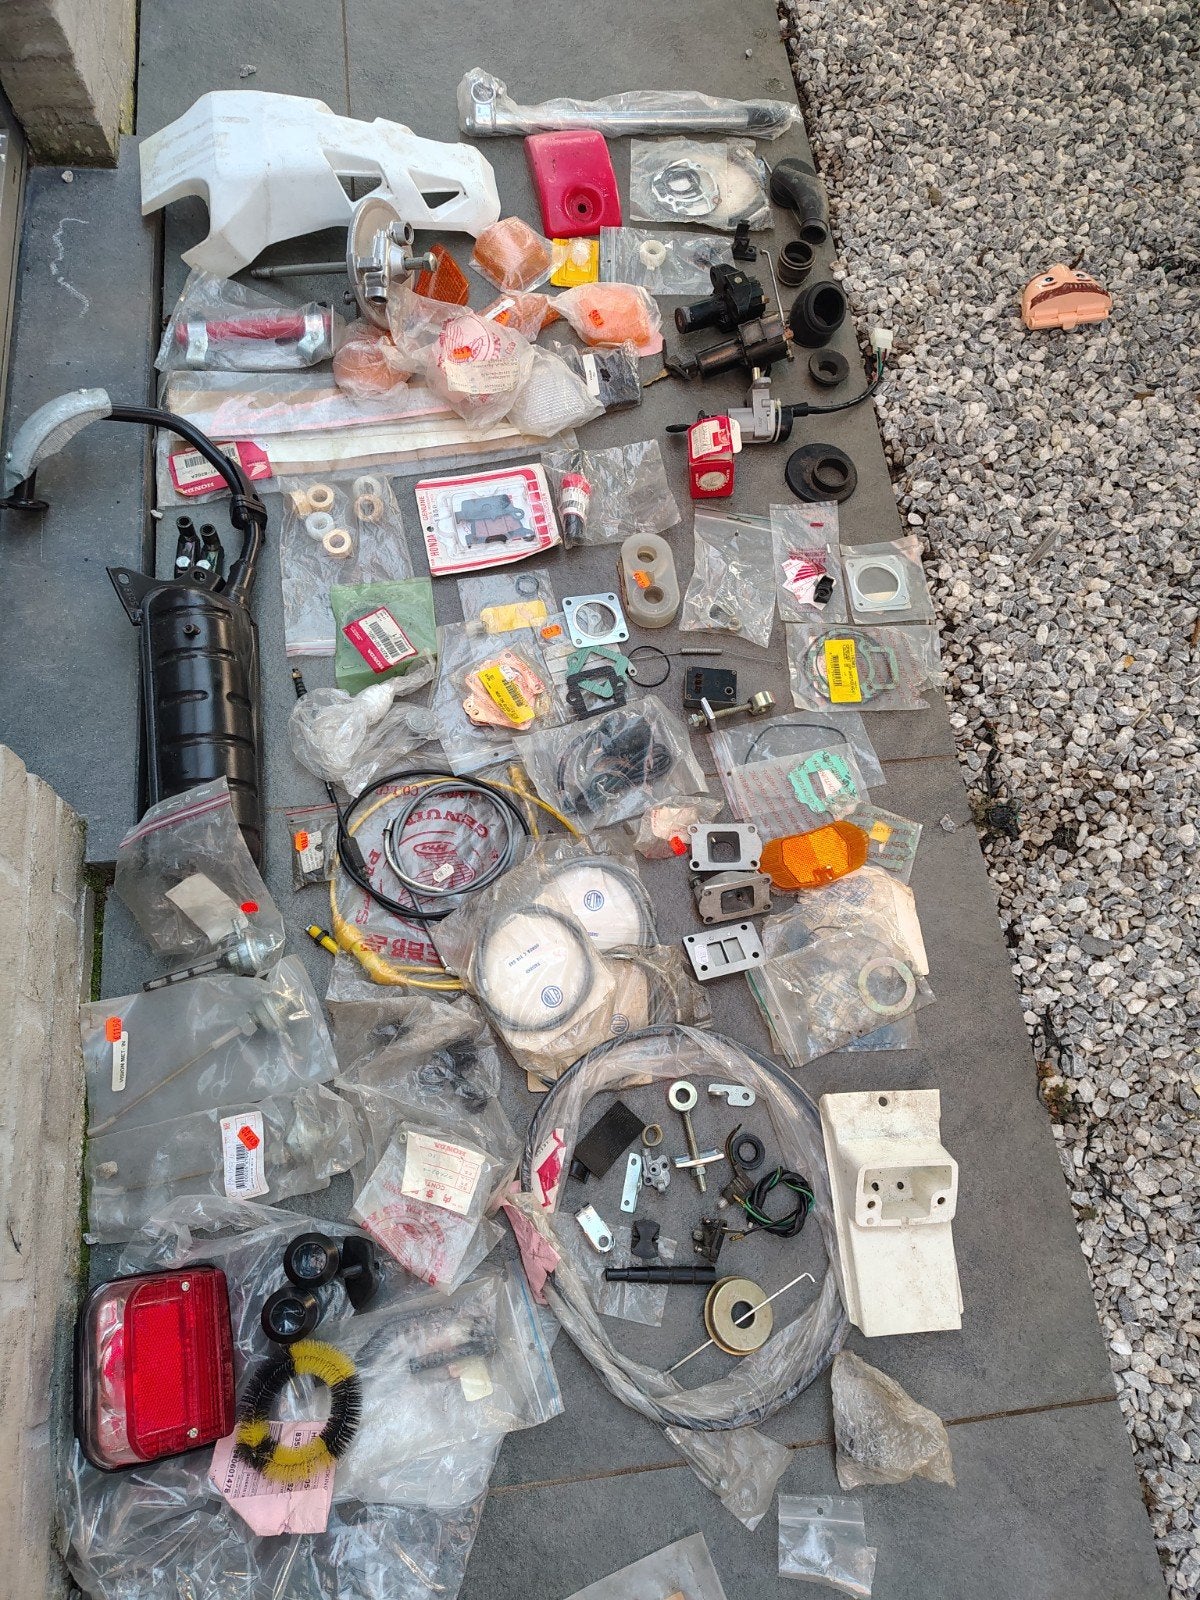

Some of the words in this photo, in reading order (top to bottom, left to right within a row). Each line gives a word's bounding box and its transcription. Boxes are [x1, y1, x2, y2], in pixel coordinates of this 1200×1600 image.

[181, 481, 214, 495] HONDA
[418, 495, 429, 521] GENUINE
[427, 533, 439, 557] HONDA
[367, 648, 385, 670] HONDA
[434, 1142, 466, 1157] HONDA
